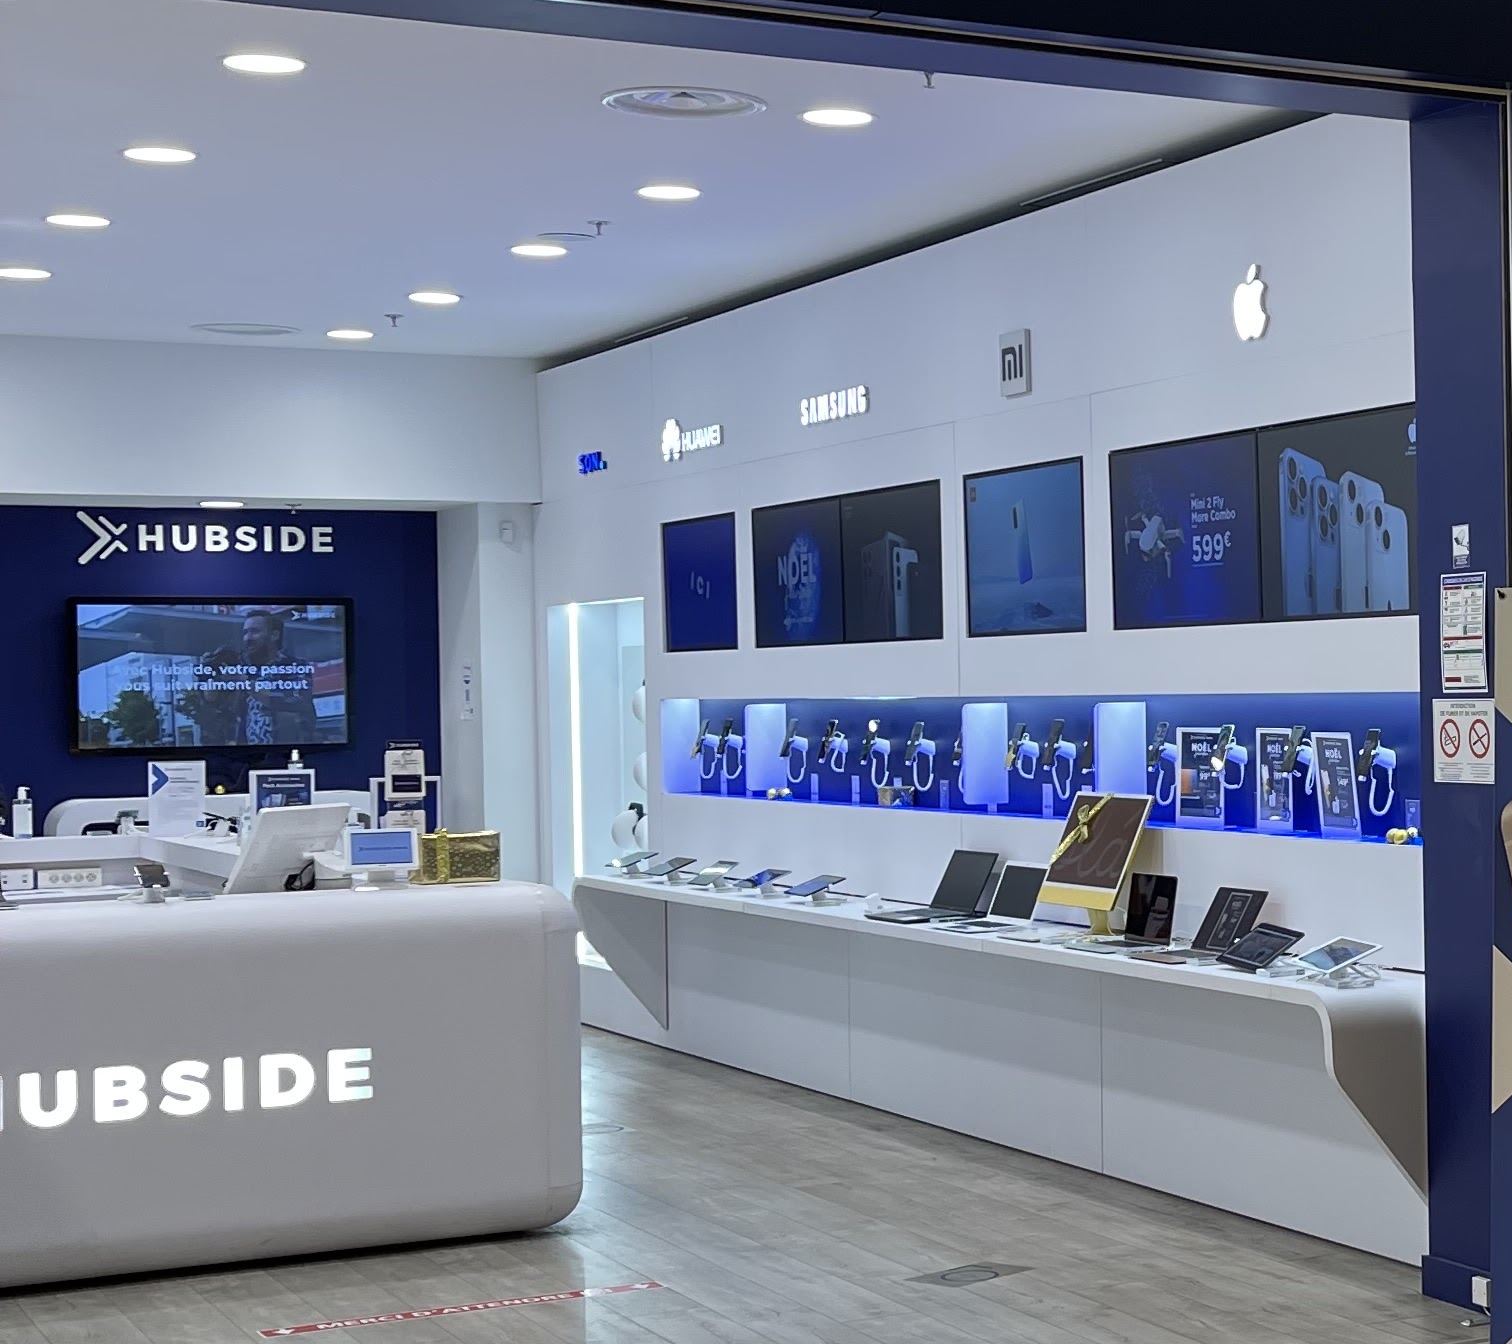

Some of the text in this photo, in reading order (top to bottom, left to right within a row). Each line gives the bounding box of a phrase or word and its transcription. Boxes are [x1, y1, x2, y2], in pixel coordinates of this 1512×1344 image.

[800, 385, 868, 427] SAMSUNG
[681, 424, 722, 452] HUAWEI
[1206, 496, 1212, 509] 2
[1212, 496, 1224, 509] Fly
[1210, 508, 1236, 522] Combo
[137, 524, 335, 553] HUBSIDE
[151, 663, 217, 676] Hubside,
[219, 666, 257, 675] votre
[260, 663, 315, 677] passion
[184, 679, 252, 690] vraiment
[254, 679, 309, 691] partout
[0, 1048, 374, 1131] UBSIDE
